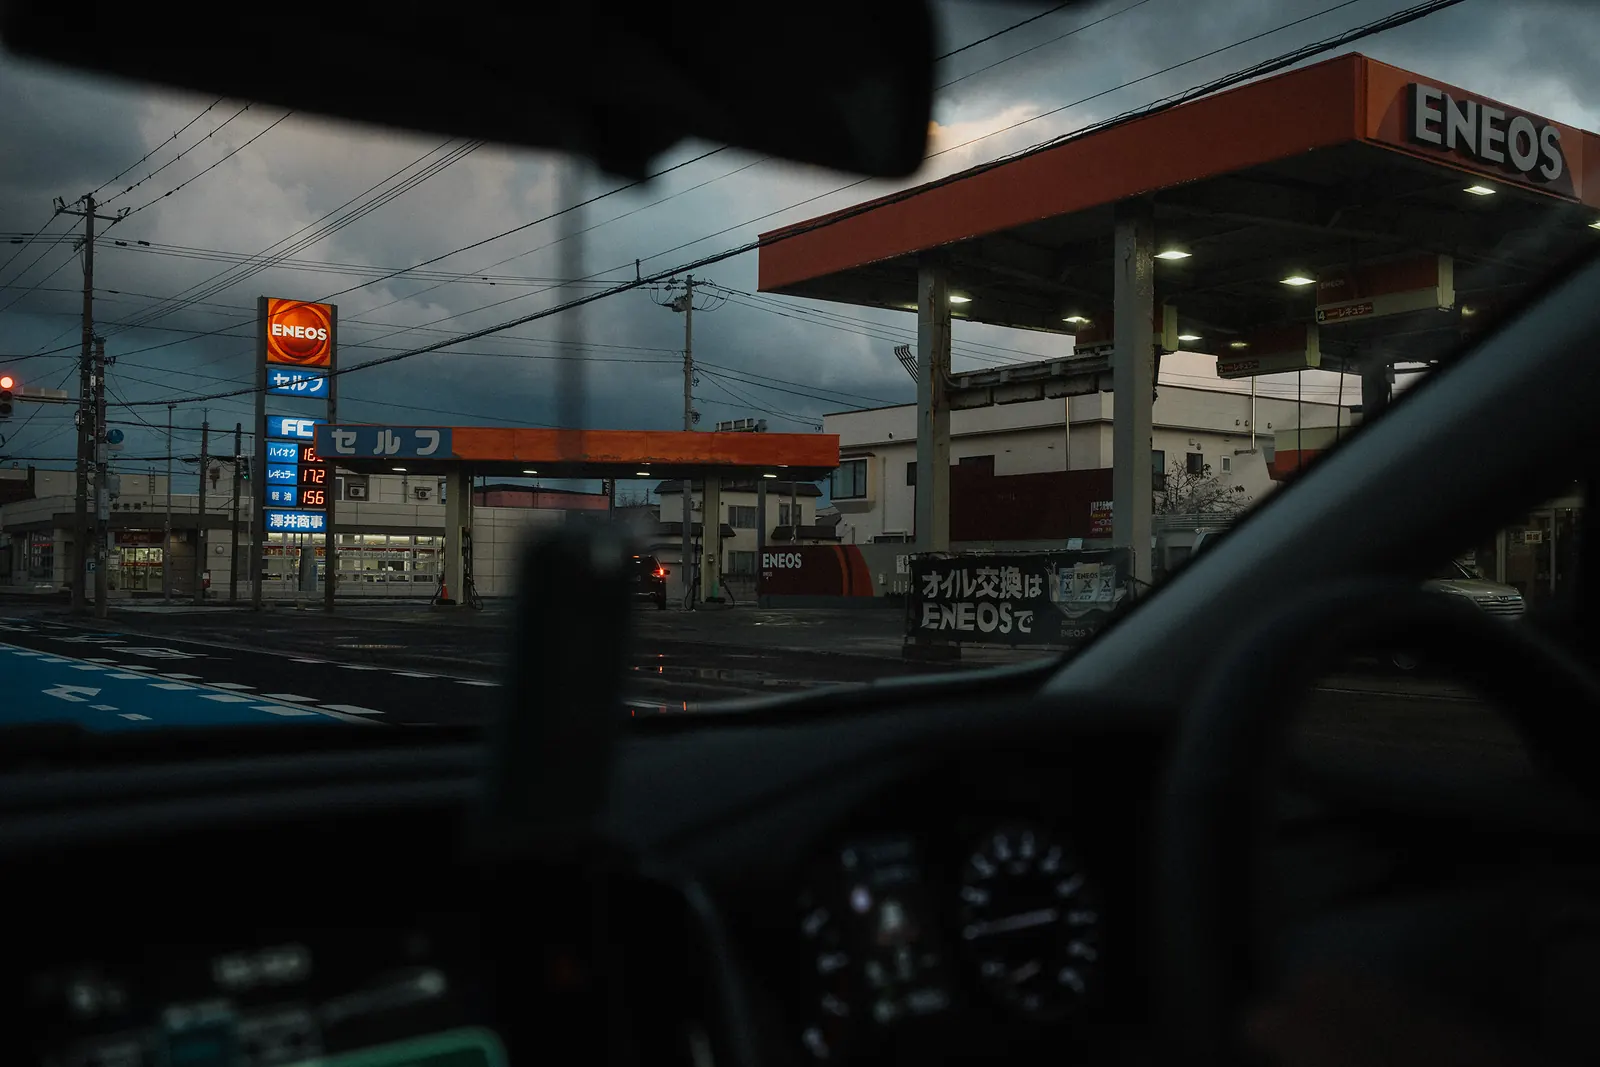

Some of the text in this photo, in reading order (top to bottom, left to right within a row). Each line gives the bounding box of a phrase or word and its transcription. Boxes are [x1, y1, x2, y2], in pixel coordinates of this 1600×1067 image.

[1412, 82, 1563, 180] ENEOS
[271, 323, 328, 341] ENEOS
[273, 372, 324, 392] セルフ
[331, 428, 441, 456] セルフ
[269, 447, 297, 458] ハイオク
[268, 469, 326, 484] レギュラー 172
[302, 490, 325, 505] 156
[270, 513, 324, 529] 澤井商事
[762, 552, 802, 569] ENEOS
[921, 565, 1043, 600] オイル交換は
[1076, 572, 1098, 580] ENEOS
